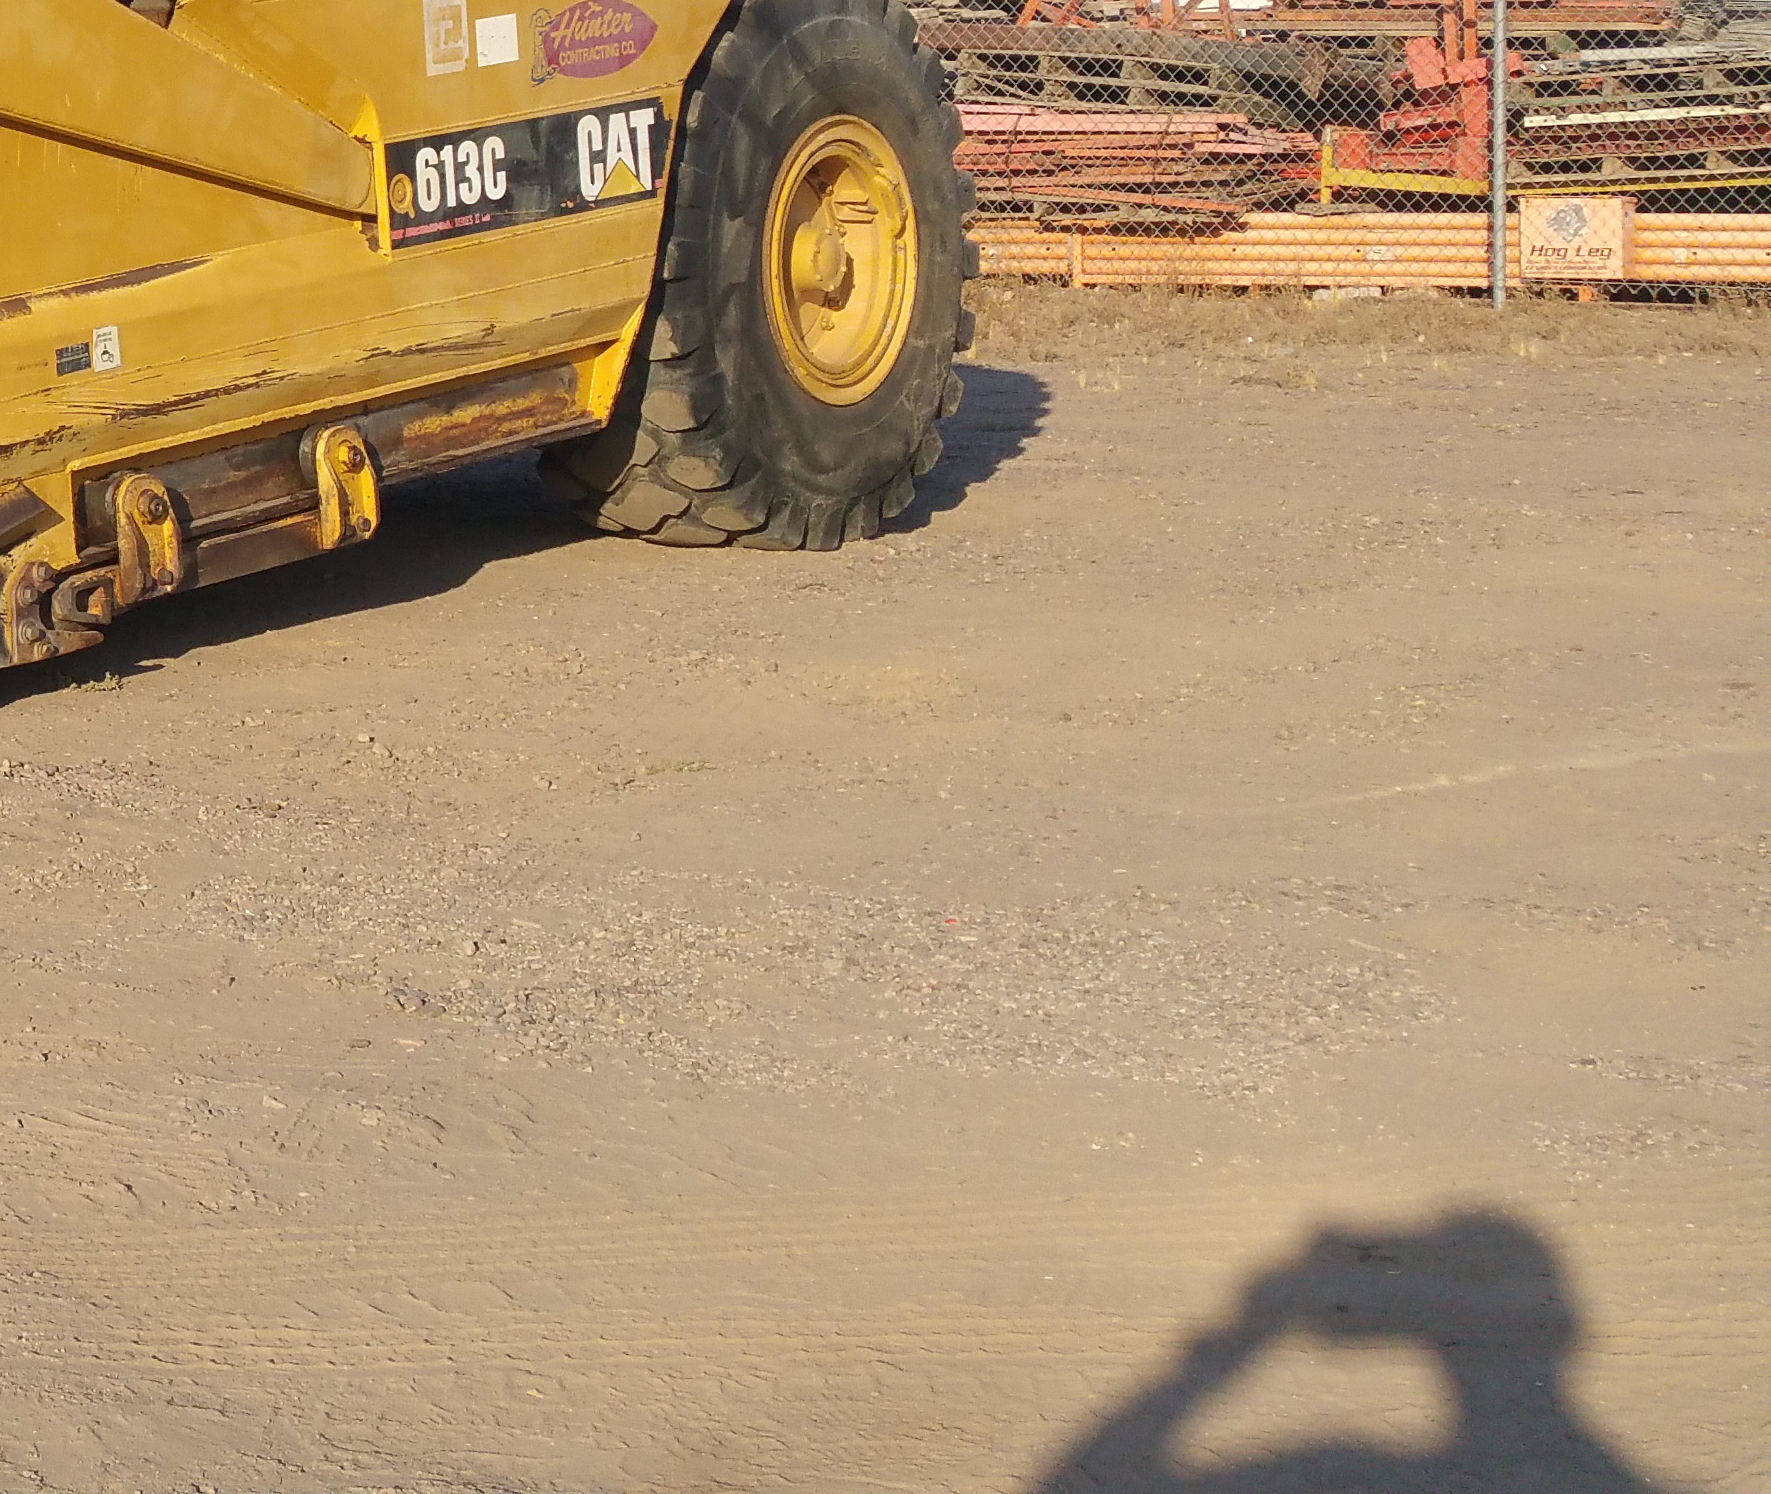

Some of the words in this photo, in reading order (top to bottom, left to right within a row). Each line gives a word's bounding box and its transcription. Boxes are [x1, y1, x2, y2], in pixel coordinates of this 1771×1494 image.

[550, 7, 634, 50] Hunter
[558, 41, 620, 66] CONTRACTING
[621, 39, 637, 56] CO.
[415, 135, 508, 213] 613C
[576, 107, 655, 201] CAT
[1529, 245, 1568, 261] Hog
[1575, 245, 1612, 261] Leg
